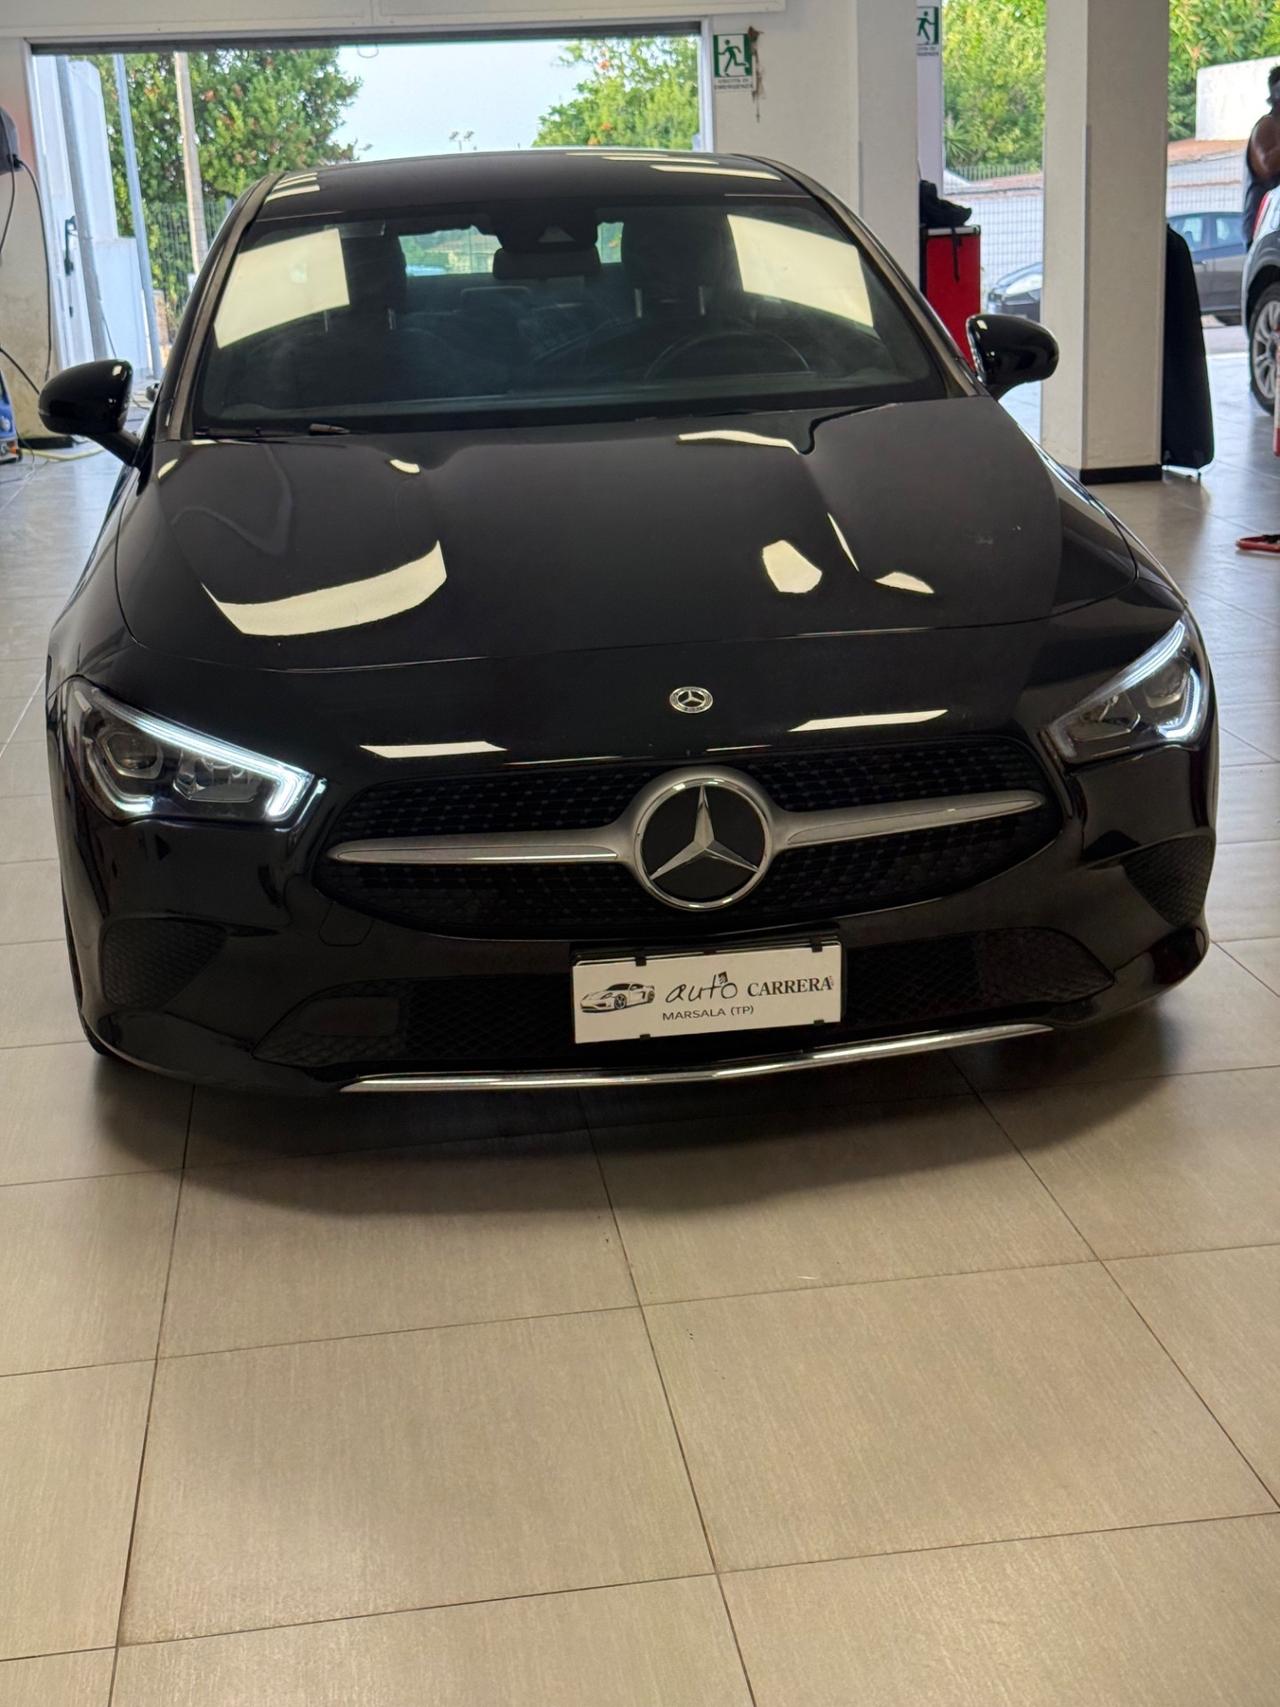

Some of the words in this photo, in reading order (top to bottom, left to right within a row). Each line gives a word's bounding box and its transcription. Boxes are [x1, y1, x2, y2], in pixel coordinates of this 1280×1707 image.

[665, 974, 738, 1003] auto
[747, 976, 832, 998] CARRERA
[662, 1008, 726, 1022] MARSALA
[730, 1005, 754, 1017] (TP)
